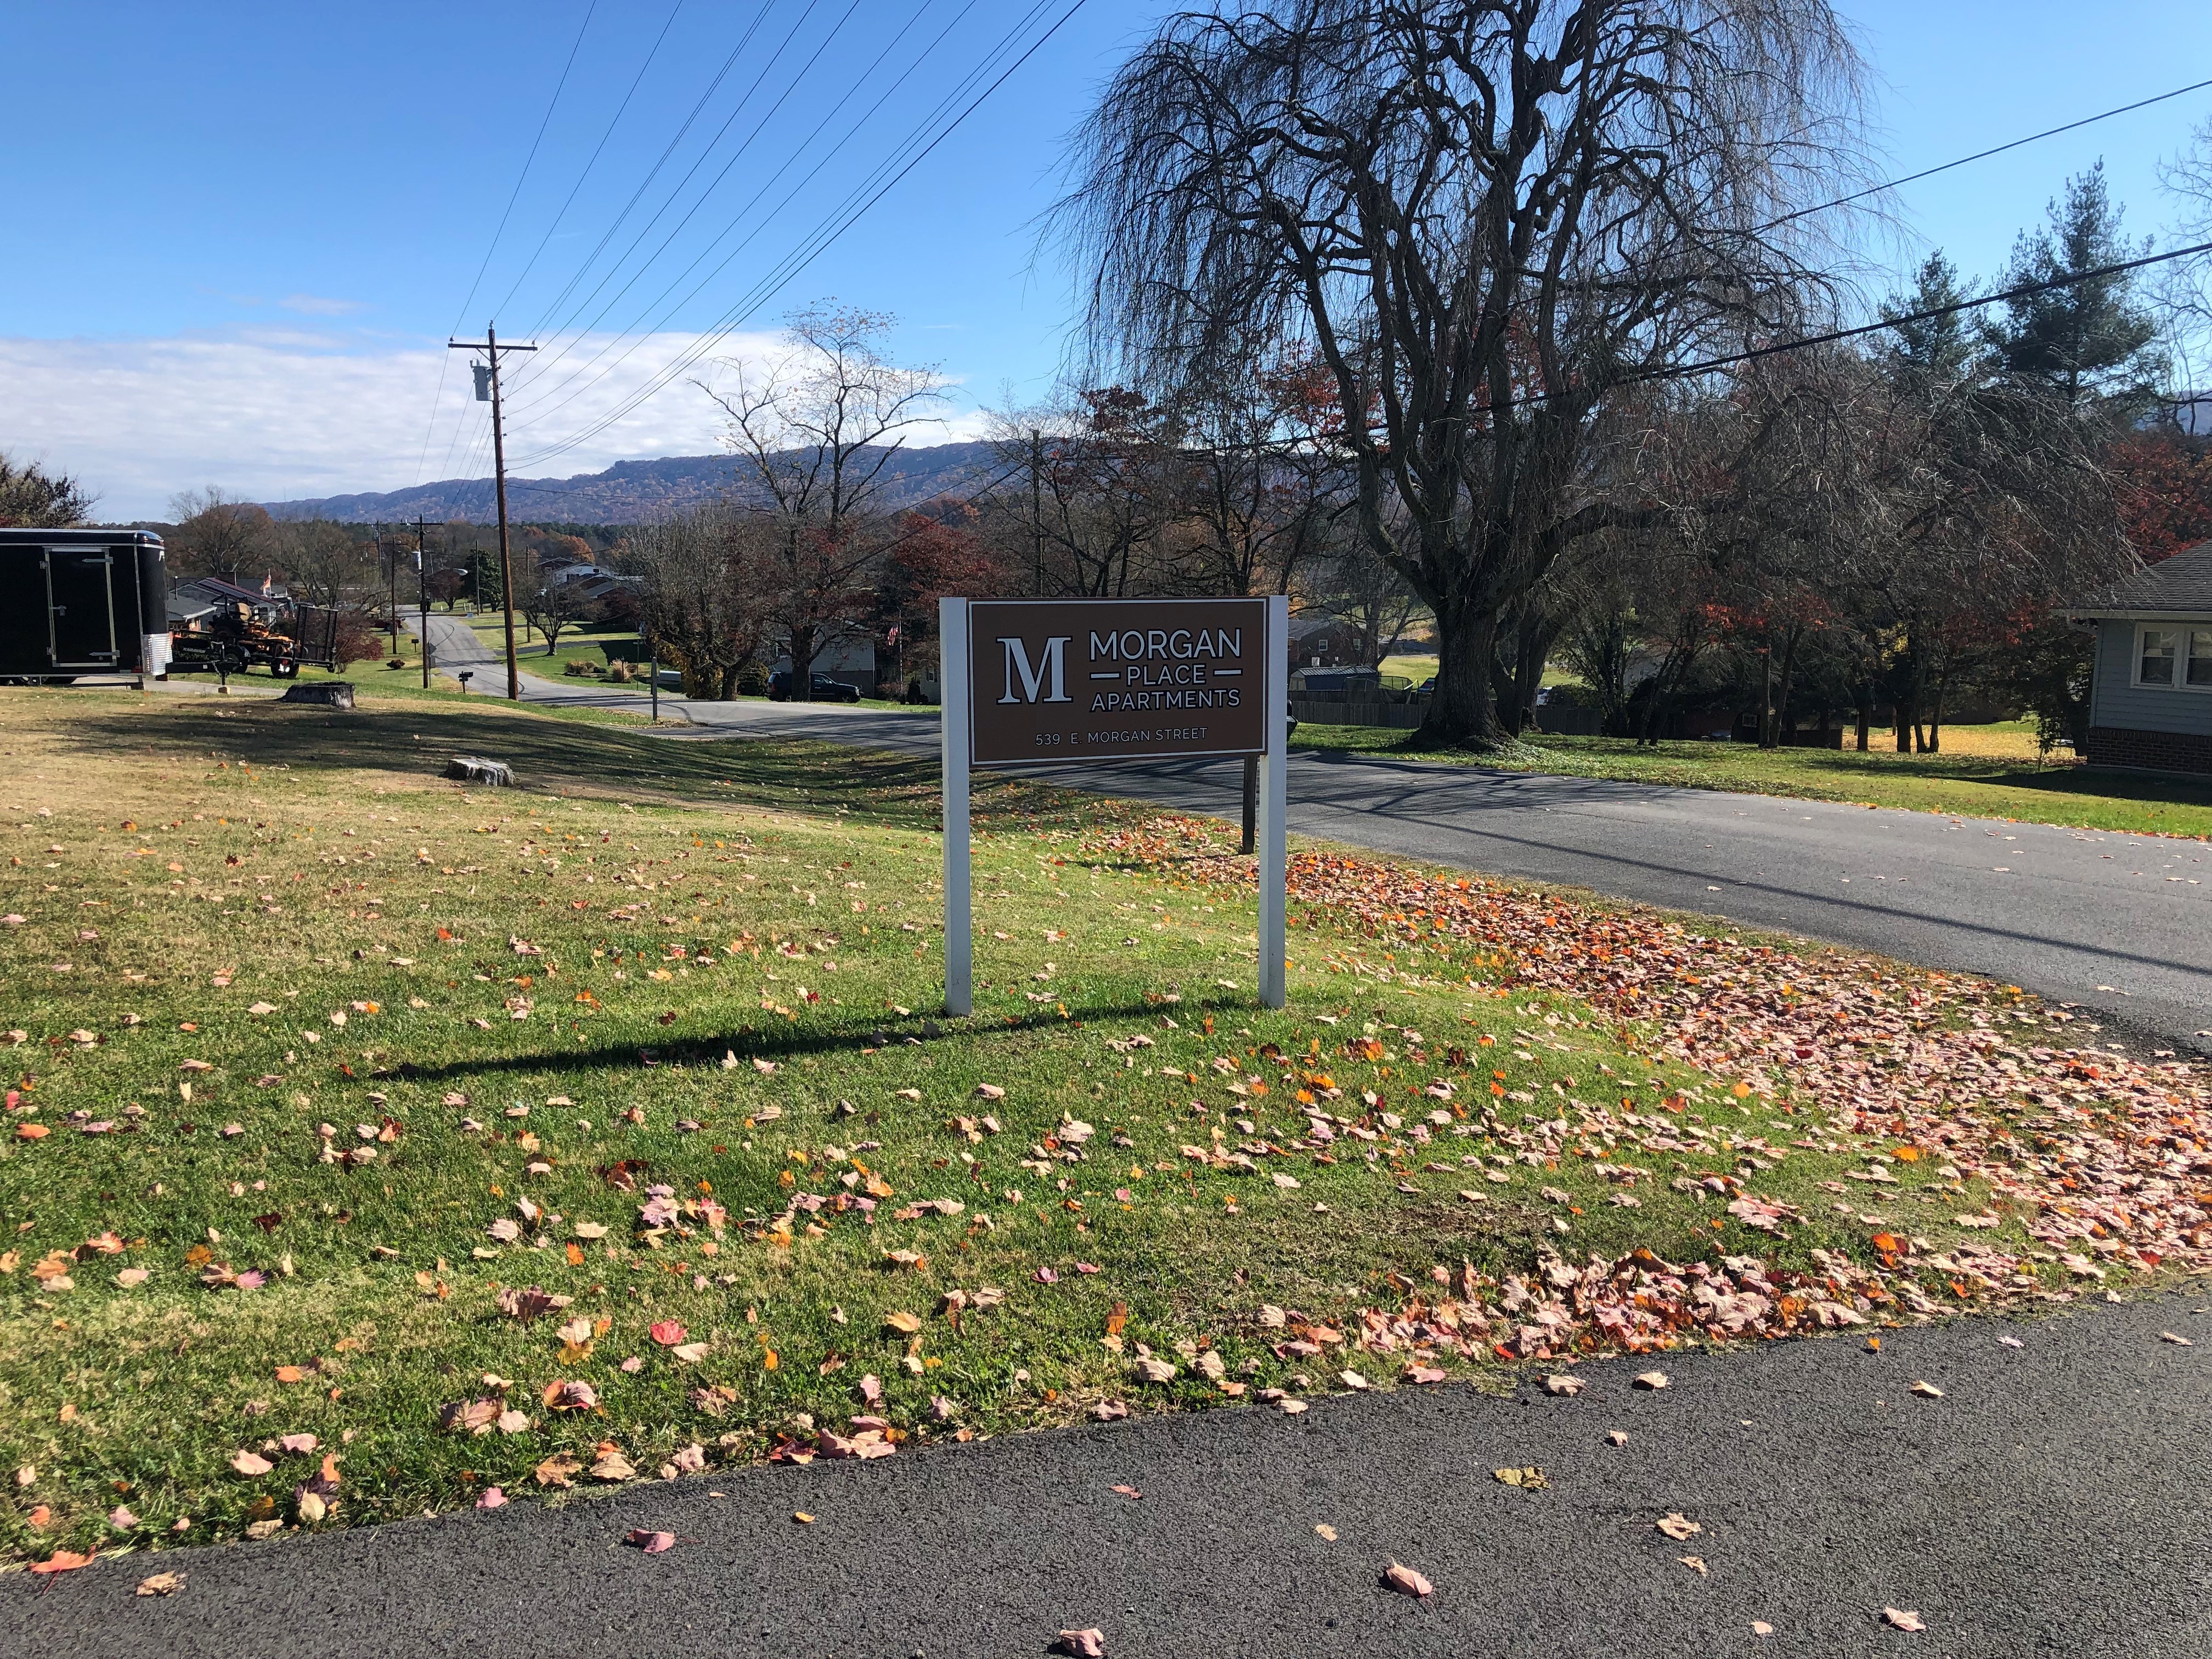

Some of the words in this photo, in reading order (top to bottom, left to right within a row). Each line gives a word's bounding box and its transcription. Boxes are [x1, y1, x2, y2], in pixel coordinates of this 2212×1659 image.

[1090, 629, 1240, 660] MORGAN
[996, 637, 1073, 704] M
[1127, 664, 1206, 686] PLACE
[1091, 689, 1240, 712] APARTMENTS
[1035, 733, 1060, 746] 539
[1070, 732, 1082, 744] E.
[1088, 730, 1150, 743] MORGAN
[1155, 727, 1207, 740] STREET
